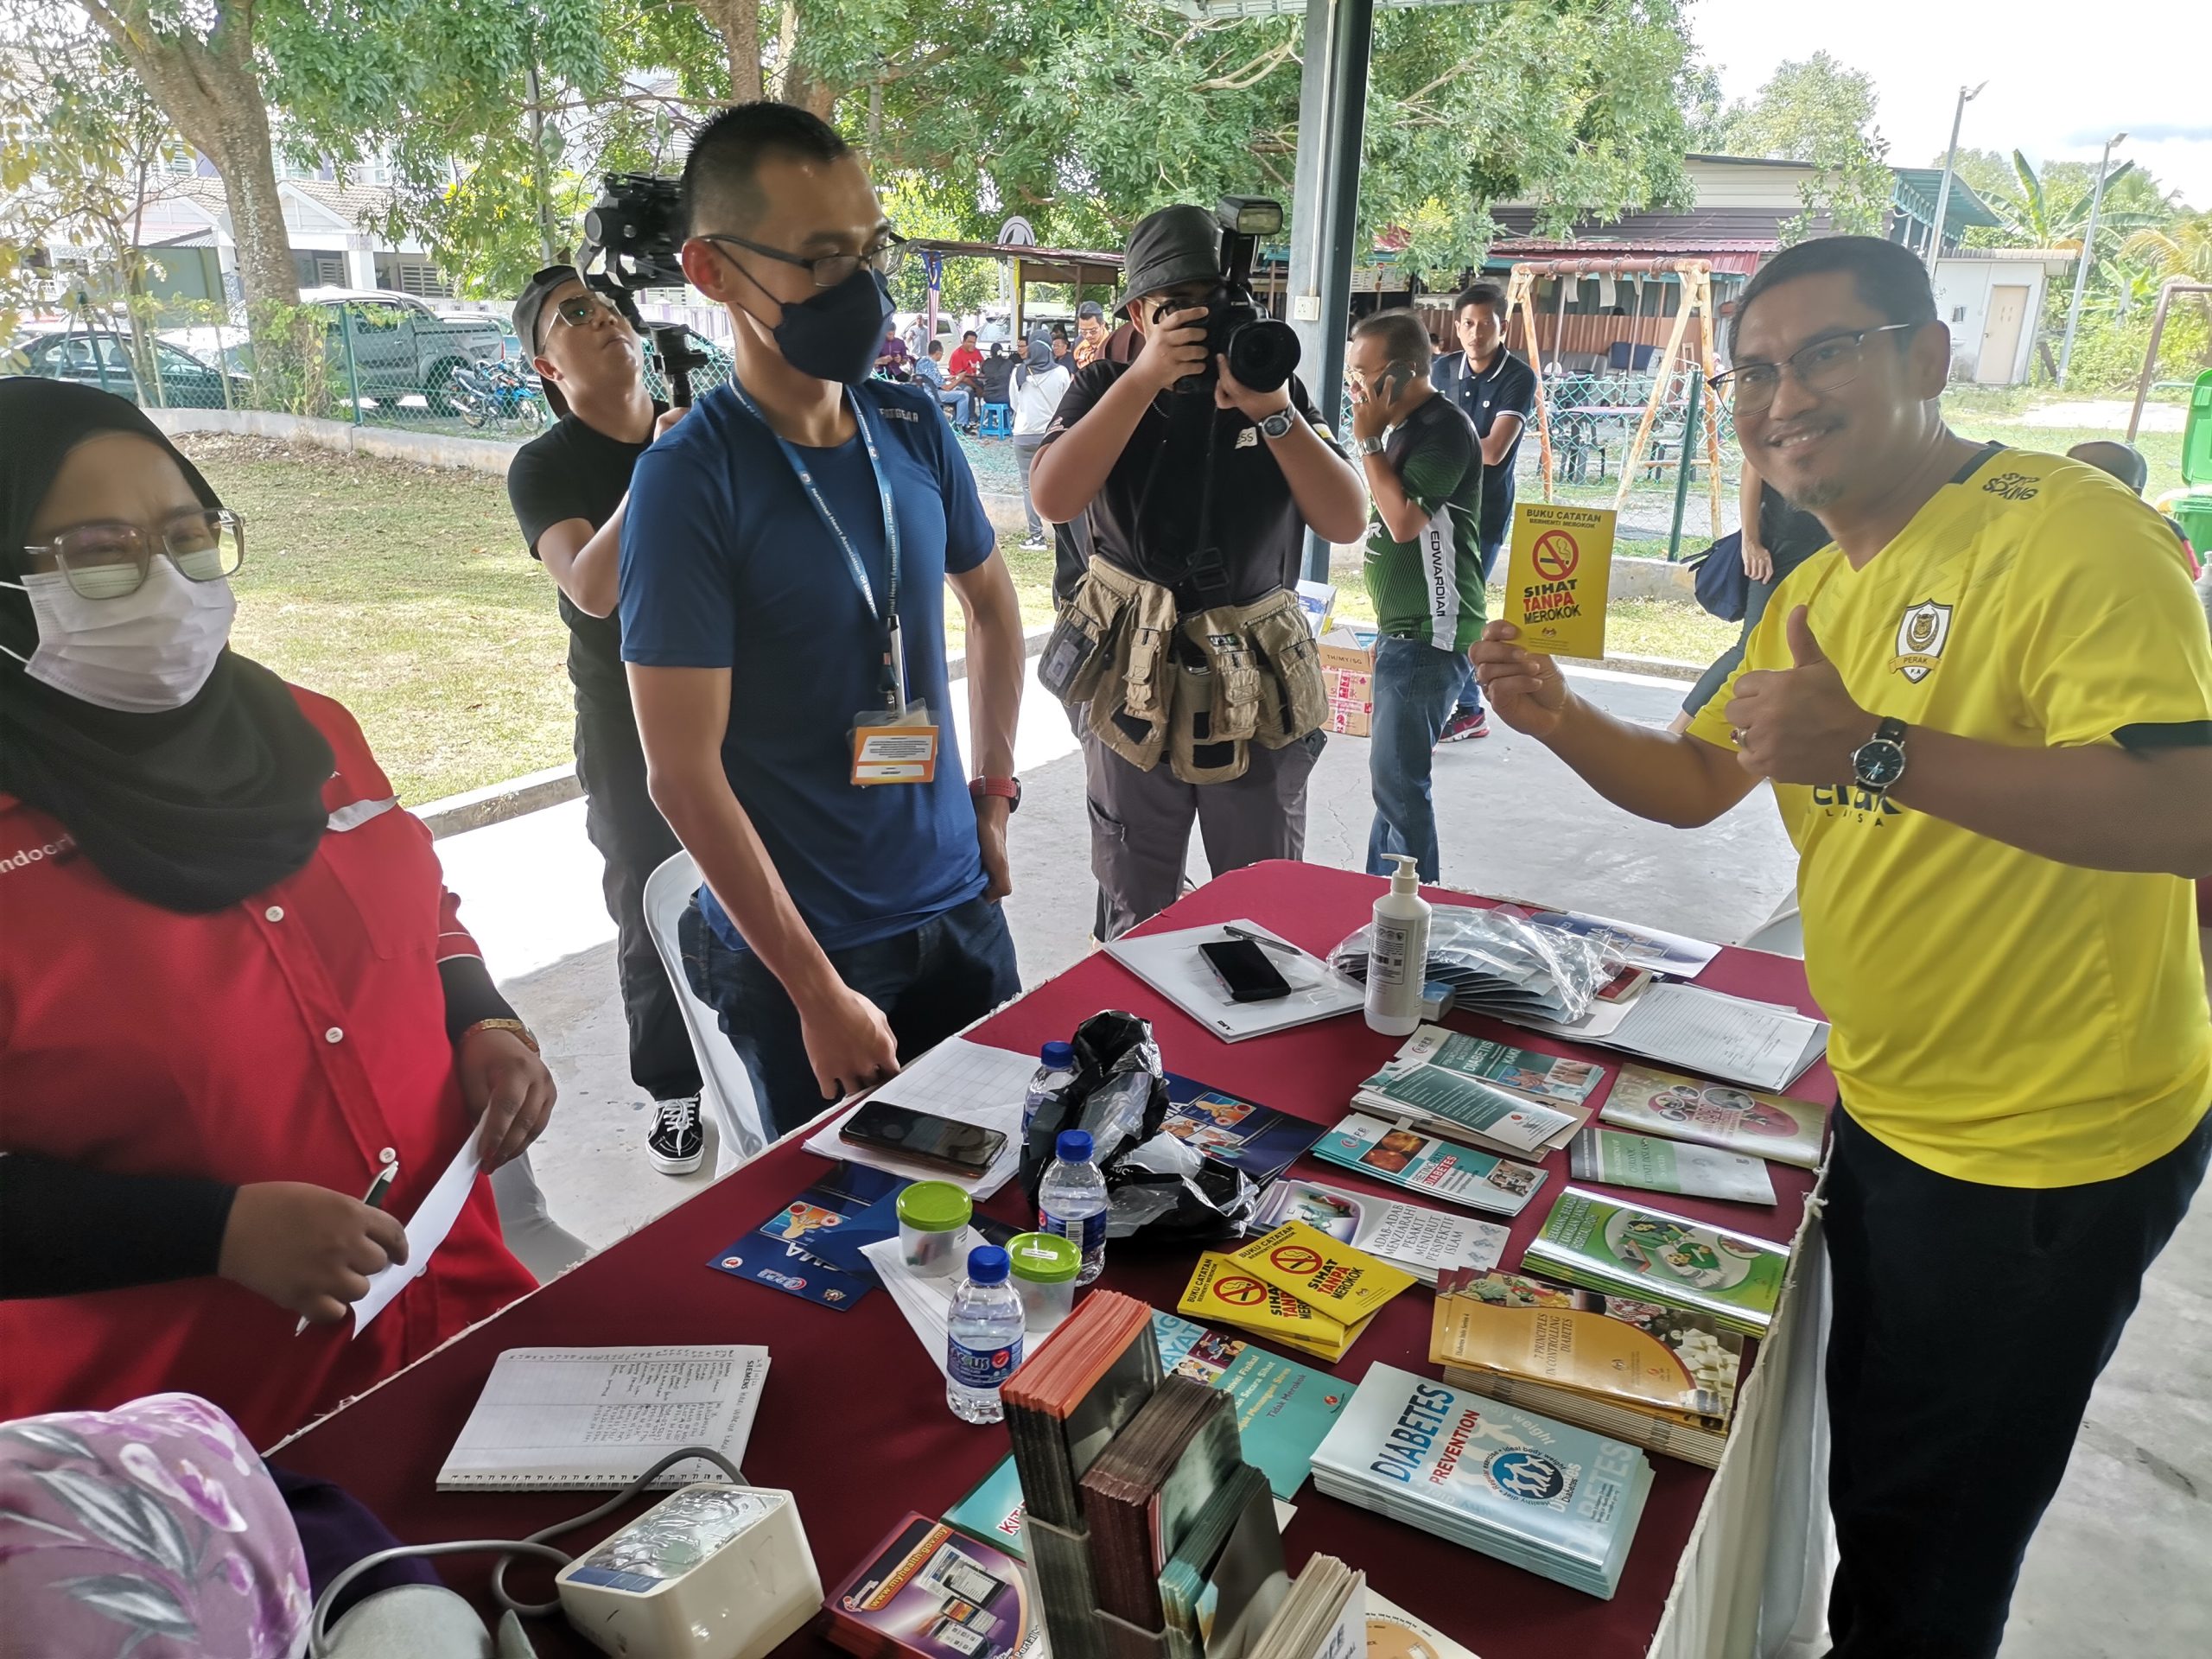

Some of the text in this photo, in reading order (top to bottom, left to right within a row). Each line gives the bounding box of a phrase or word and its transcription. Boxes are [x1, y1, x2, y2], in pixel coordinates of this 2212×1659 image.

[811, 487, 831, 518] National
[830, 514, 844, 537] Heart
[840, 535, 862, 575] Association
[1527, 509, 1601, 523] BUKU CATATAN
[1529, 518, 1561, 527] BERHENTI
[890, 534, 899, 576] Association
[889, 575, 898, 596] Heart
[1524, 579, 1578, 598] SIHAT
[1523, 592, 1575, 613] TANPA
[1523, 604, 1581, 625] MEROKOK
[1903, 656, 1929, 665] PERAK
[1463, 1040, 1494, 1072] DIABETIS
[1503, 1048, 1522, 1065] KAKI
[1412, 1152, 1447, 1183] RETINOPATI
[1424, 1155, 1459, 1186] DIABETES
[1239, 1225, 1294, 1259] BUKU CATATAN
[1374, 1205, 1404, 1250] ADAB-ADAB
[1384, 1205, 1418, 1256] MENZIARAHI
[1402, 1217, 1426, 1249] PESAKIT
[1414, 1216, 1441, 1256] MENURUT
[1426, 1216, 1455, 1262] PERSPEKTIF
[1444, 1230, 1465, 1255] ISLAM
[1247, 1243, 1274, 1260] BERHENTI
[1187, 1258, 1213, 1303] BUKU CATATAN
[1307, 1258, 1338, 1290] SIHAT
[1317, 1265, 1351, 1294] TANPA
[1331, 1267, 1365, 1300] MEROKOK
[1267, 1281, 1283, 1317] SIHA
[1455, 1340, 1465, 1357] Diabetes
[1534, 1313, 1548, 1360] 7 PRINCIPLES
[1546, 1315, 1561, 1376] IN CONTROLLING
[1560, 1318, 1574, 1353] DIABETES
[739, 1359, 754, 1390] SIEMENS
[1241, 1355, 1261, 1376] Fizikal
[1243, 1376, 1263, 1399] Secara
[1260, 1361, 1277, 1381] Sihat
[1273, 1368, 1292, 1390] Stres
[1267, 1374, 1306, 1419] Tidak Merokok
[1370, 1383, 1455, 1483] DIABETES
[1512, 1414, 1556, 1446] weight
[1428, 1409, 1480, 1485] PREVENTION
[1482, 1450, 1501, 1470] exercise
[1522, 1446, 1543, 1458] body
[1542, 1453, 1567, 1471] weight
[1484, 1469, 1500, 1492] Regular
[1561, 1478, 1579, 1503] Diabetes
[1503, 1491, 1551, 1508] Healthy diet
[869, 1526, 949, 1608] www.myhealth.gov.my
[1015, 1634, 1039, 1659] Portal
